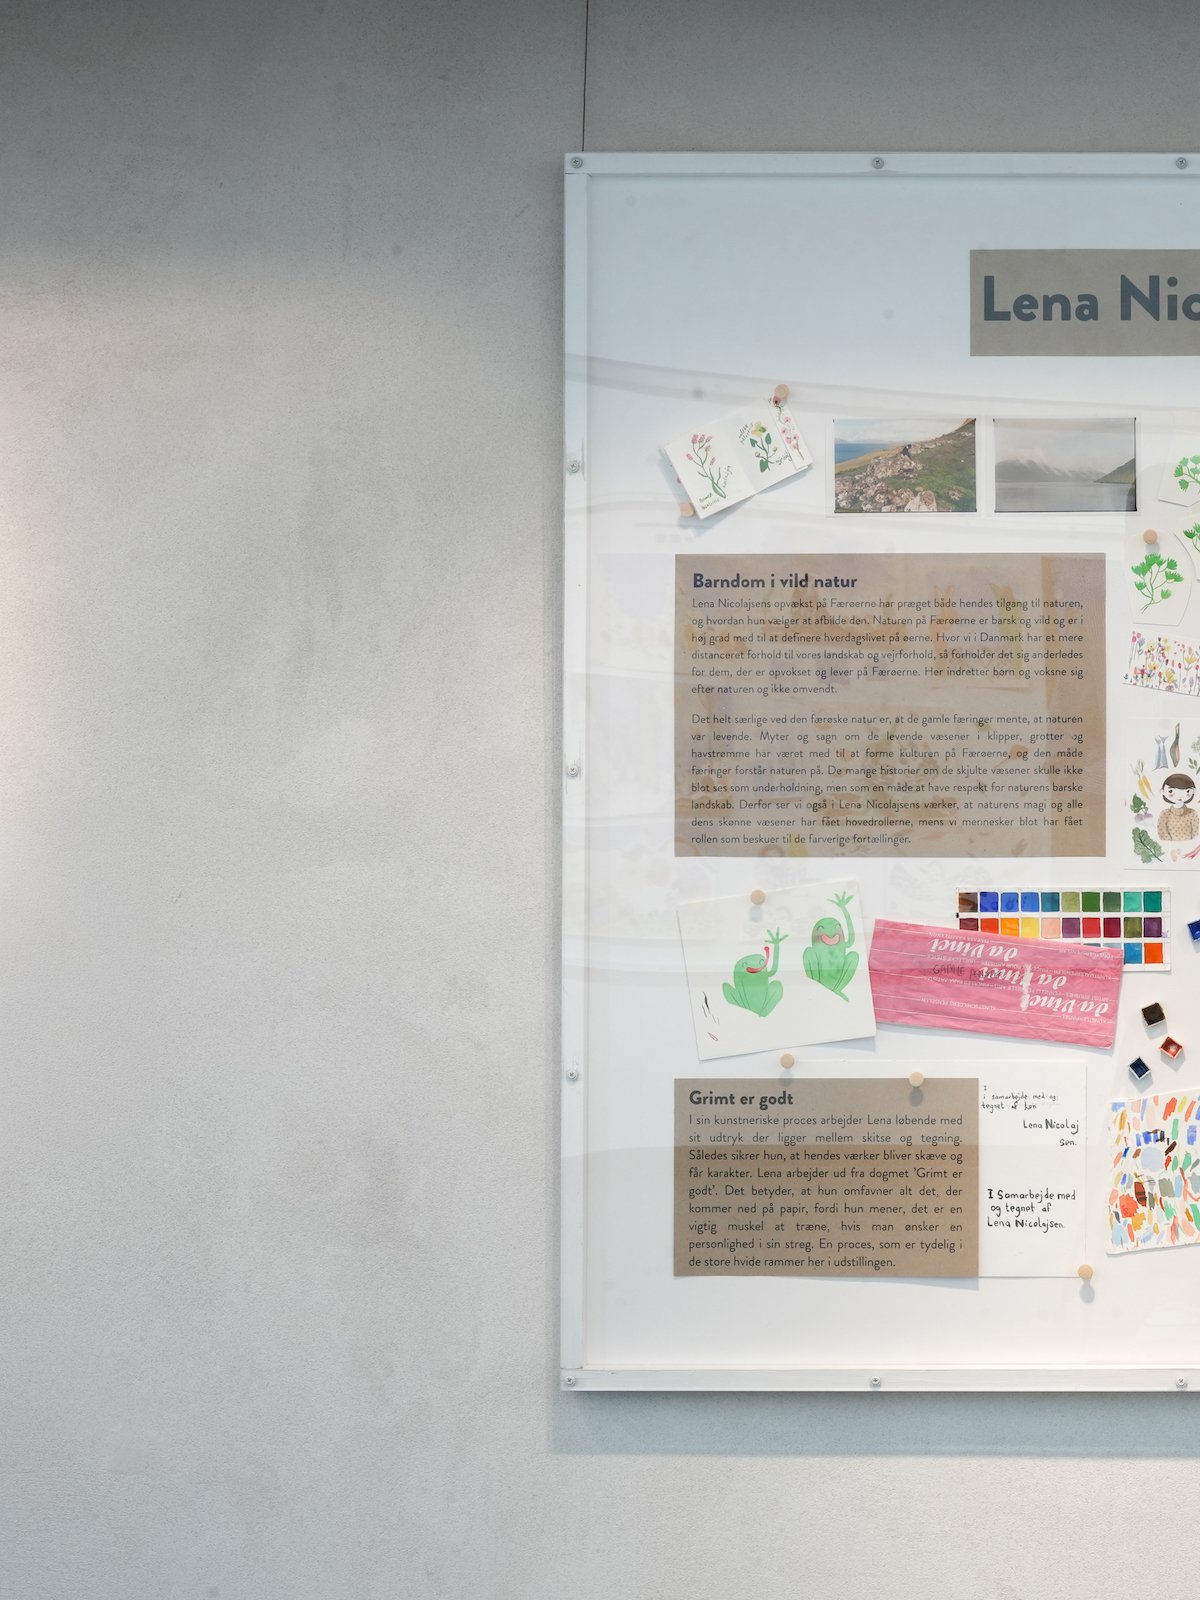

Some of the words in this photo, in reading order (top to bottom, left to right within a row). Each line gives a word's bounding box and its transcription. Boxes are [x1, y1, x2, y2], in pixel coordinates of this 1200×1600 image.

[983, 274, 1099, 321] Lena
[693, 573, 765, 588] Barndom
[779, 573, 808, 588] vild
[814, 573, 857, 588] natur
[692, 597, 714, 608] Lena
[718, 597, 771, 611] Nicolajsens
[773, 597, 813, 611] opvækst
[816, 597, 826, 611] på
[830, 597, 876, 608] Færøerne
[878, 597, 893, 608] har
[897, 597, 931, 611] præget
[934, 597, 956, 608] både
[959, 597, 993, 608] hendes
[996, 597, 1028, 611] tilgang
[1030, 597, 1039, 608] til
[1043, 597, 1083, 610] naturen,
[691, 649, 743, 659] distanceret
[747, 649, 781, 659] forhold
[784, 649, 793, 659] til
[796, 651, 821, 659] vores
[823, 649, 864, 659] landskab
[867, 651, 878, 662] og
[881, 649, 936, 662] vejrforhold,
[938, 649, 948, 659] så
[951, 648, 994, 659] forholder
[997, 648, 1013, 659] det
[1016, 648, 1029, 662] sig
[1031, 648, 1083, 659] anderledes
[691, 764, 731, 778] færinger
[735, 764, 766, 775] forstår
[769, 764, 806, 775] naturen
[810, 764, 823, 778] på.
[827, 764, 842, 775] De
[845, 766, 877, 778] mange
[880, 764, 919, 775] historier
[923, 766, 938, 775] om
[941, 764, 953, 775] de
[956, 764, 987, 778] skjulte
[990, 766, 1030, 775] væsener
[1033, 764, 1060, 775] skulle
[1063, 764, 1083, 775] ikke
[928, 938, 982, 958] Vinci
[689, 1091, 735, 1105] Grimt
[739, 1094, 755, 1105] er
[759, 1091, 793, 1109] godt
[981, 1101, 1004, 1114] tegnet
[696, 1115, 710, 1125] sin
[714, 1115, 779, 1125] kunstneriske
[783, 1117, 817, 1128] proces
[820, 1115, 863, 1128] arbejder
[867, 1115, 891, 1125] Lena
[895, 1115, 936, 1125] løbende
[940, 1115, 962, 1125] med
[1023, 1119, 1043, 1129] Lena
[1044, 1118, 1079, 1135] Nicolaj
[689, 1150, 727, 1160] Således
[731, 1150, 760, 1160] sikrer
[763, 1150, 786, 1162] hun,
[789, 1150, 799, 1160] at
[804, 1150, 840, 1160] hendes
[843, 1150, 879, 1160] værker
[883, 1150, 911, 1160] bliver
[915, 1150, 946, 1160] skæve
[950, 1153, 962, 1164] og
[688, 1168, 703, 1178] får
[707, 1168, 752, 1178] karakter.
[757, 1168, 782, 1178] Lena
[786, 1168, 828, 1181] arbejder
[833, 1168, 846, 1178] ud
[850, 1168, 864, 1178] fra
[869, 1168, 908, 1181] dogmet
[913, 1168, 947, 1178] ’Grimt
[952, 1170, 962, 1178] er
[987, 1188, 994, 1199] I
[1057, 1189, 1076, 1200] med
[990, 1205, 1002, 1218] og
[1005, 1202, 1035, 1218] tegnet
[1041, 1202, 1052, 1212] af
[987, 1216, 1011, 1228] Lena
